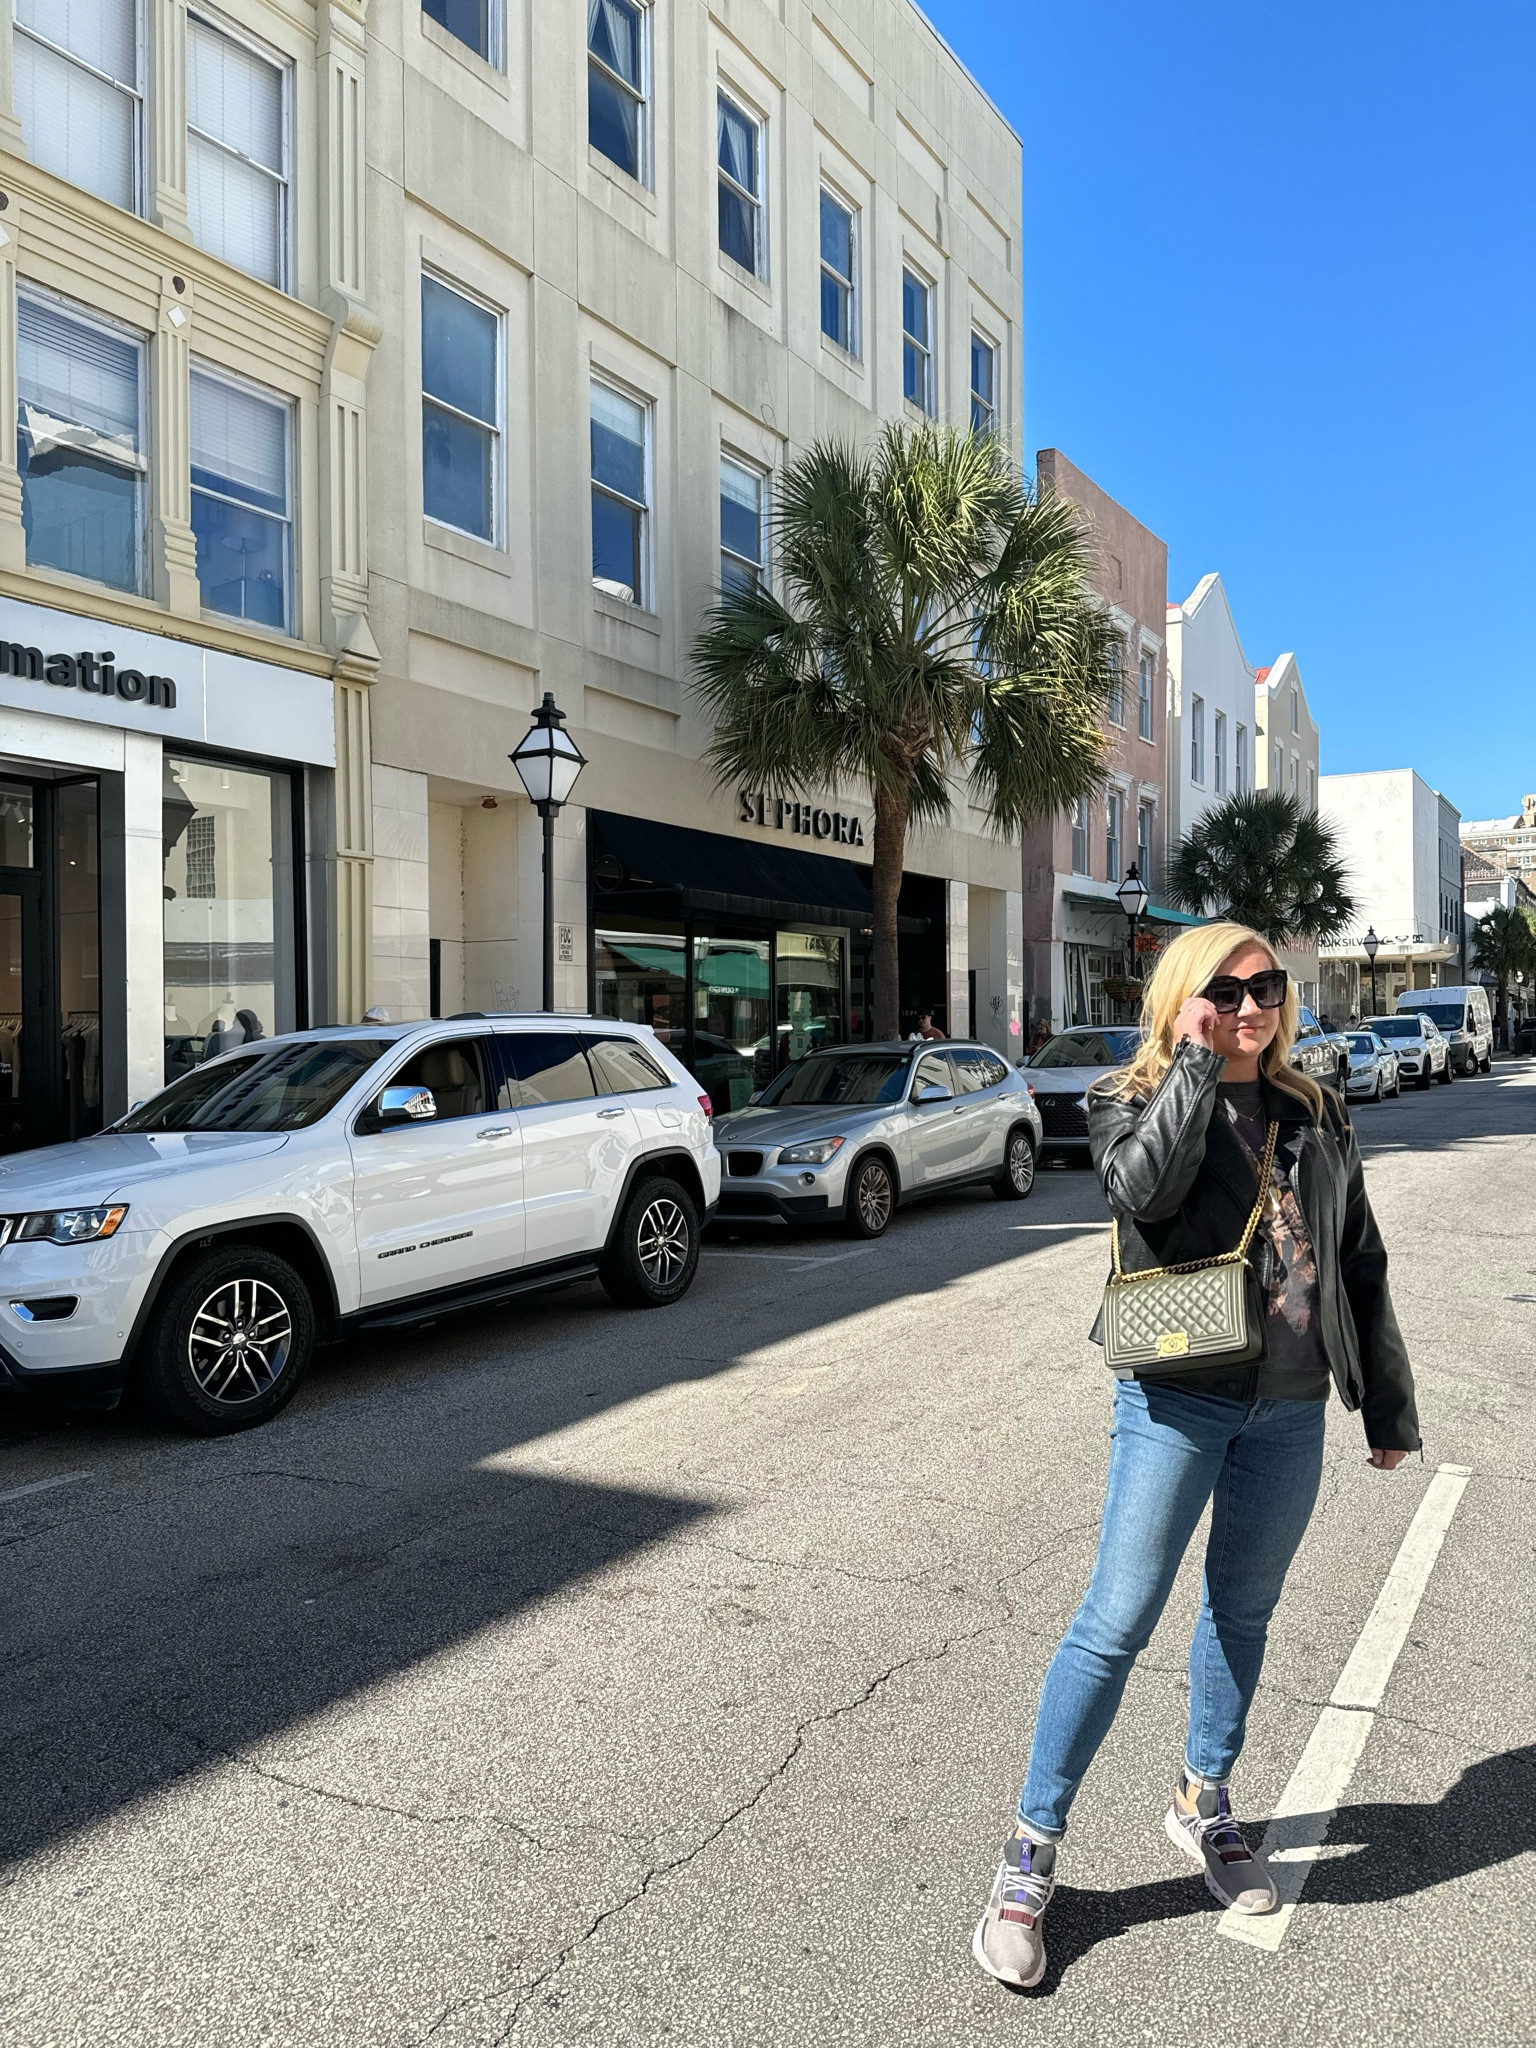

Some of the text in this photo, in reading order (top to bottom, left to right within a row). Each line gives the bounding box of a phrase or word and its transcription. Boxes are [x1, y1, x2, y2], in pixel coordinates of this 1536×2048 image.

[0, 640, 177, 709] mation
[740, 789, 865, 847] SEPHORA
[378, 1230, 473, 1259] GRAND CHEROKEE
